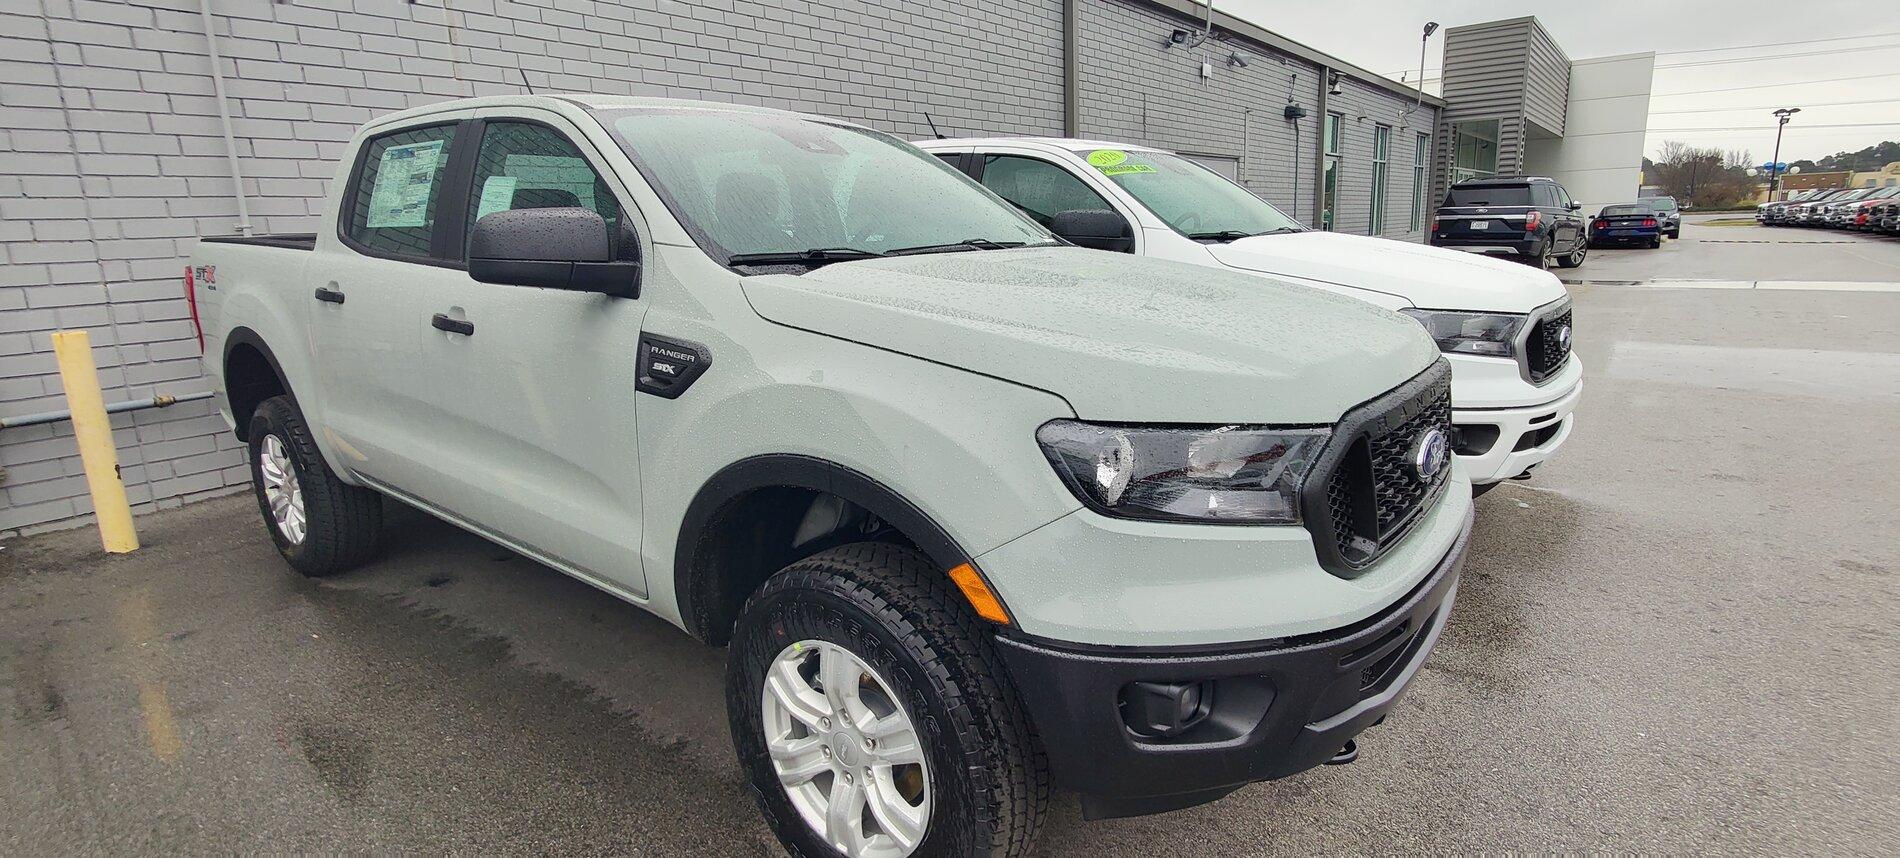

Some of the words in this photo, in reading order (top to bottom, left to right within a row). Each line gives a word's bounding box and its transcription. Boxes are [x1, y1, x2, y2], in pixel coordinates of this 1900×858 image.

[195, 265, 216, 284] STX
[651, 346, 695, 362] RANGER
[652, 362, 676, 375] STX
